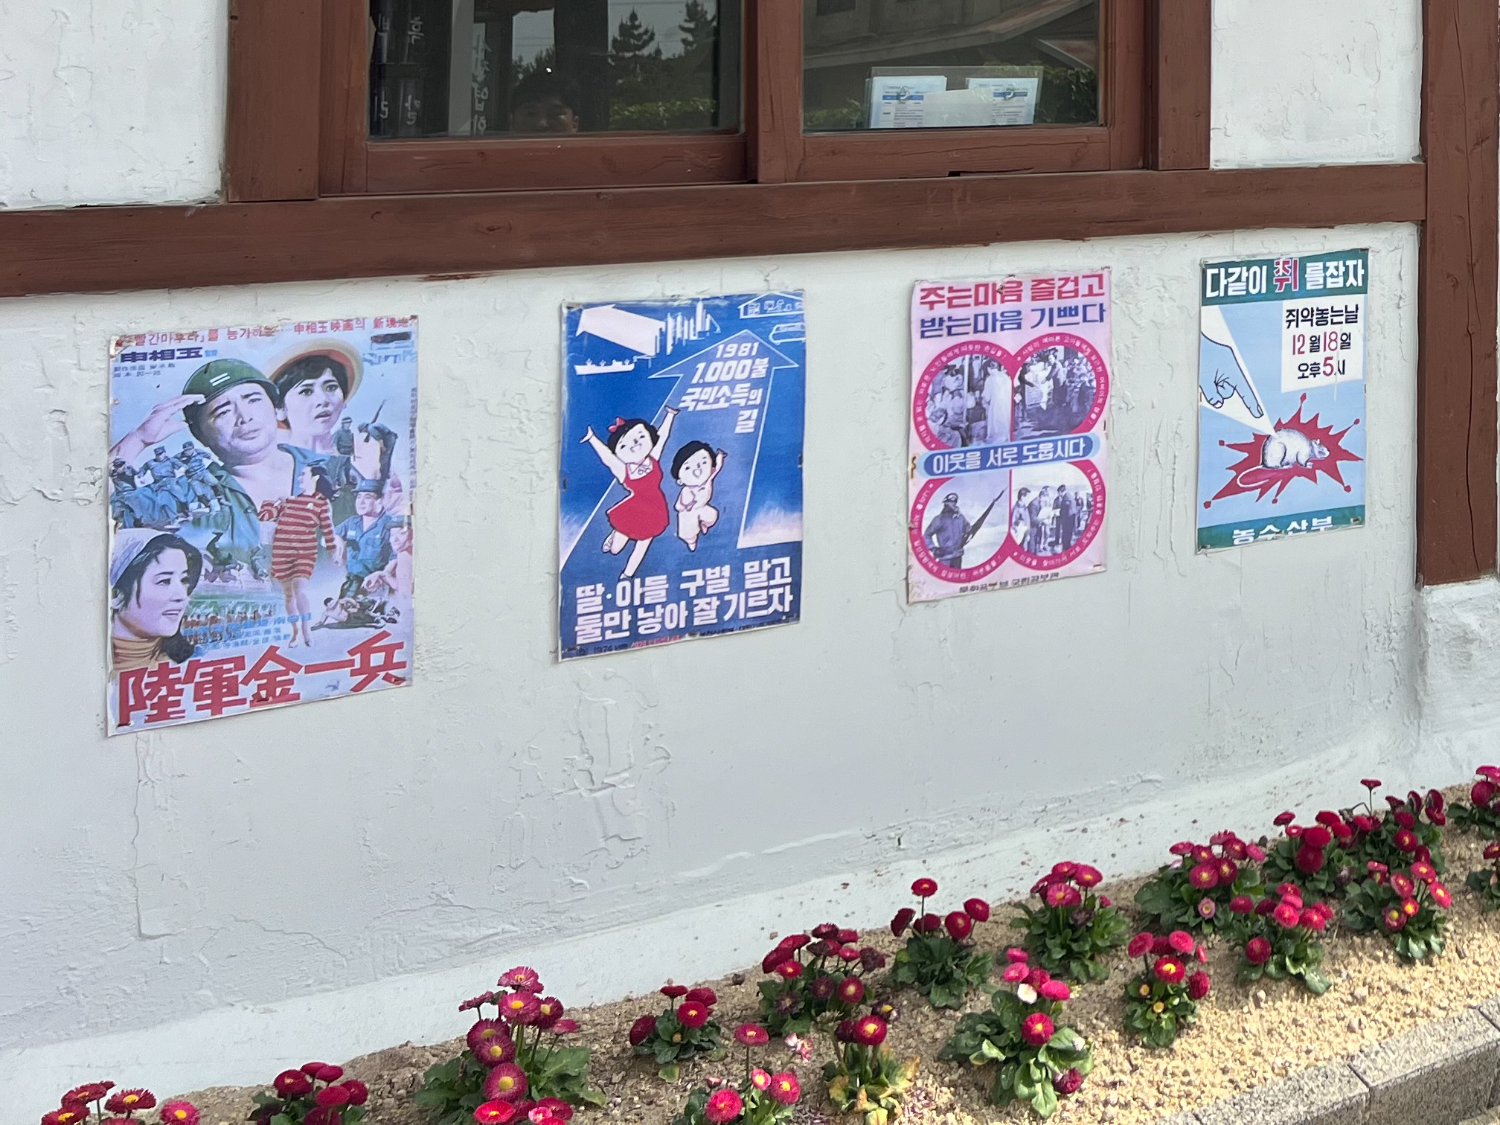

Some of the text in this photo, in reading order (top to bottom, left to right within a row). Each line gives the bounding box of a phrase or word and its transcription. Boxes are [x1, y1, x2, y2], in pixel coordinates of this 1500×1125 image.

[919, 273, 1106, 311] 주는마음 즐겁고
[1206, 265, 1267, 298] 다같이
[1273, 258, 1299, 292] 쥐
[920, 303, 1106, 339] 받는마음 기쁘다
[1285, 304, 1359, 329] 쥐약놓는날
[715, 342, 759, 358] 1981
[678, 383, 763, 411] 국민소득의
[734, 408, 759, 434] 길
[931, 438, 1086, 475] 이웃을 서로 도웁시다
[680, 564, 731, 598] 구별
[743, 556, 792, 589] 말고
[575, 609, 631, 645] 둘만
[637, 601, 688, 636] 낳아
[693, 597, 720, 625] 잘
[724, 586, 793, 622] 기르자
[117, 631, 408, 725] 陸軍金一兵
